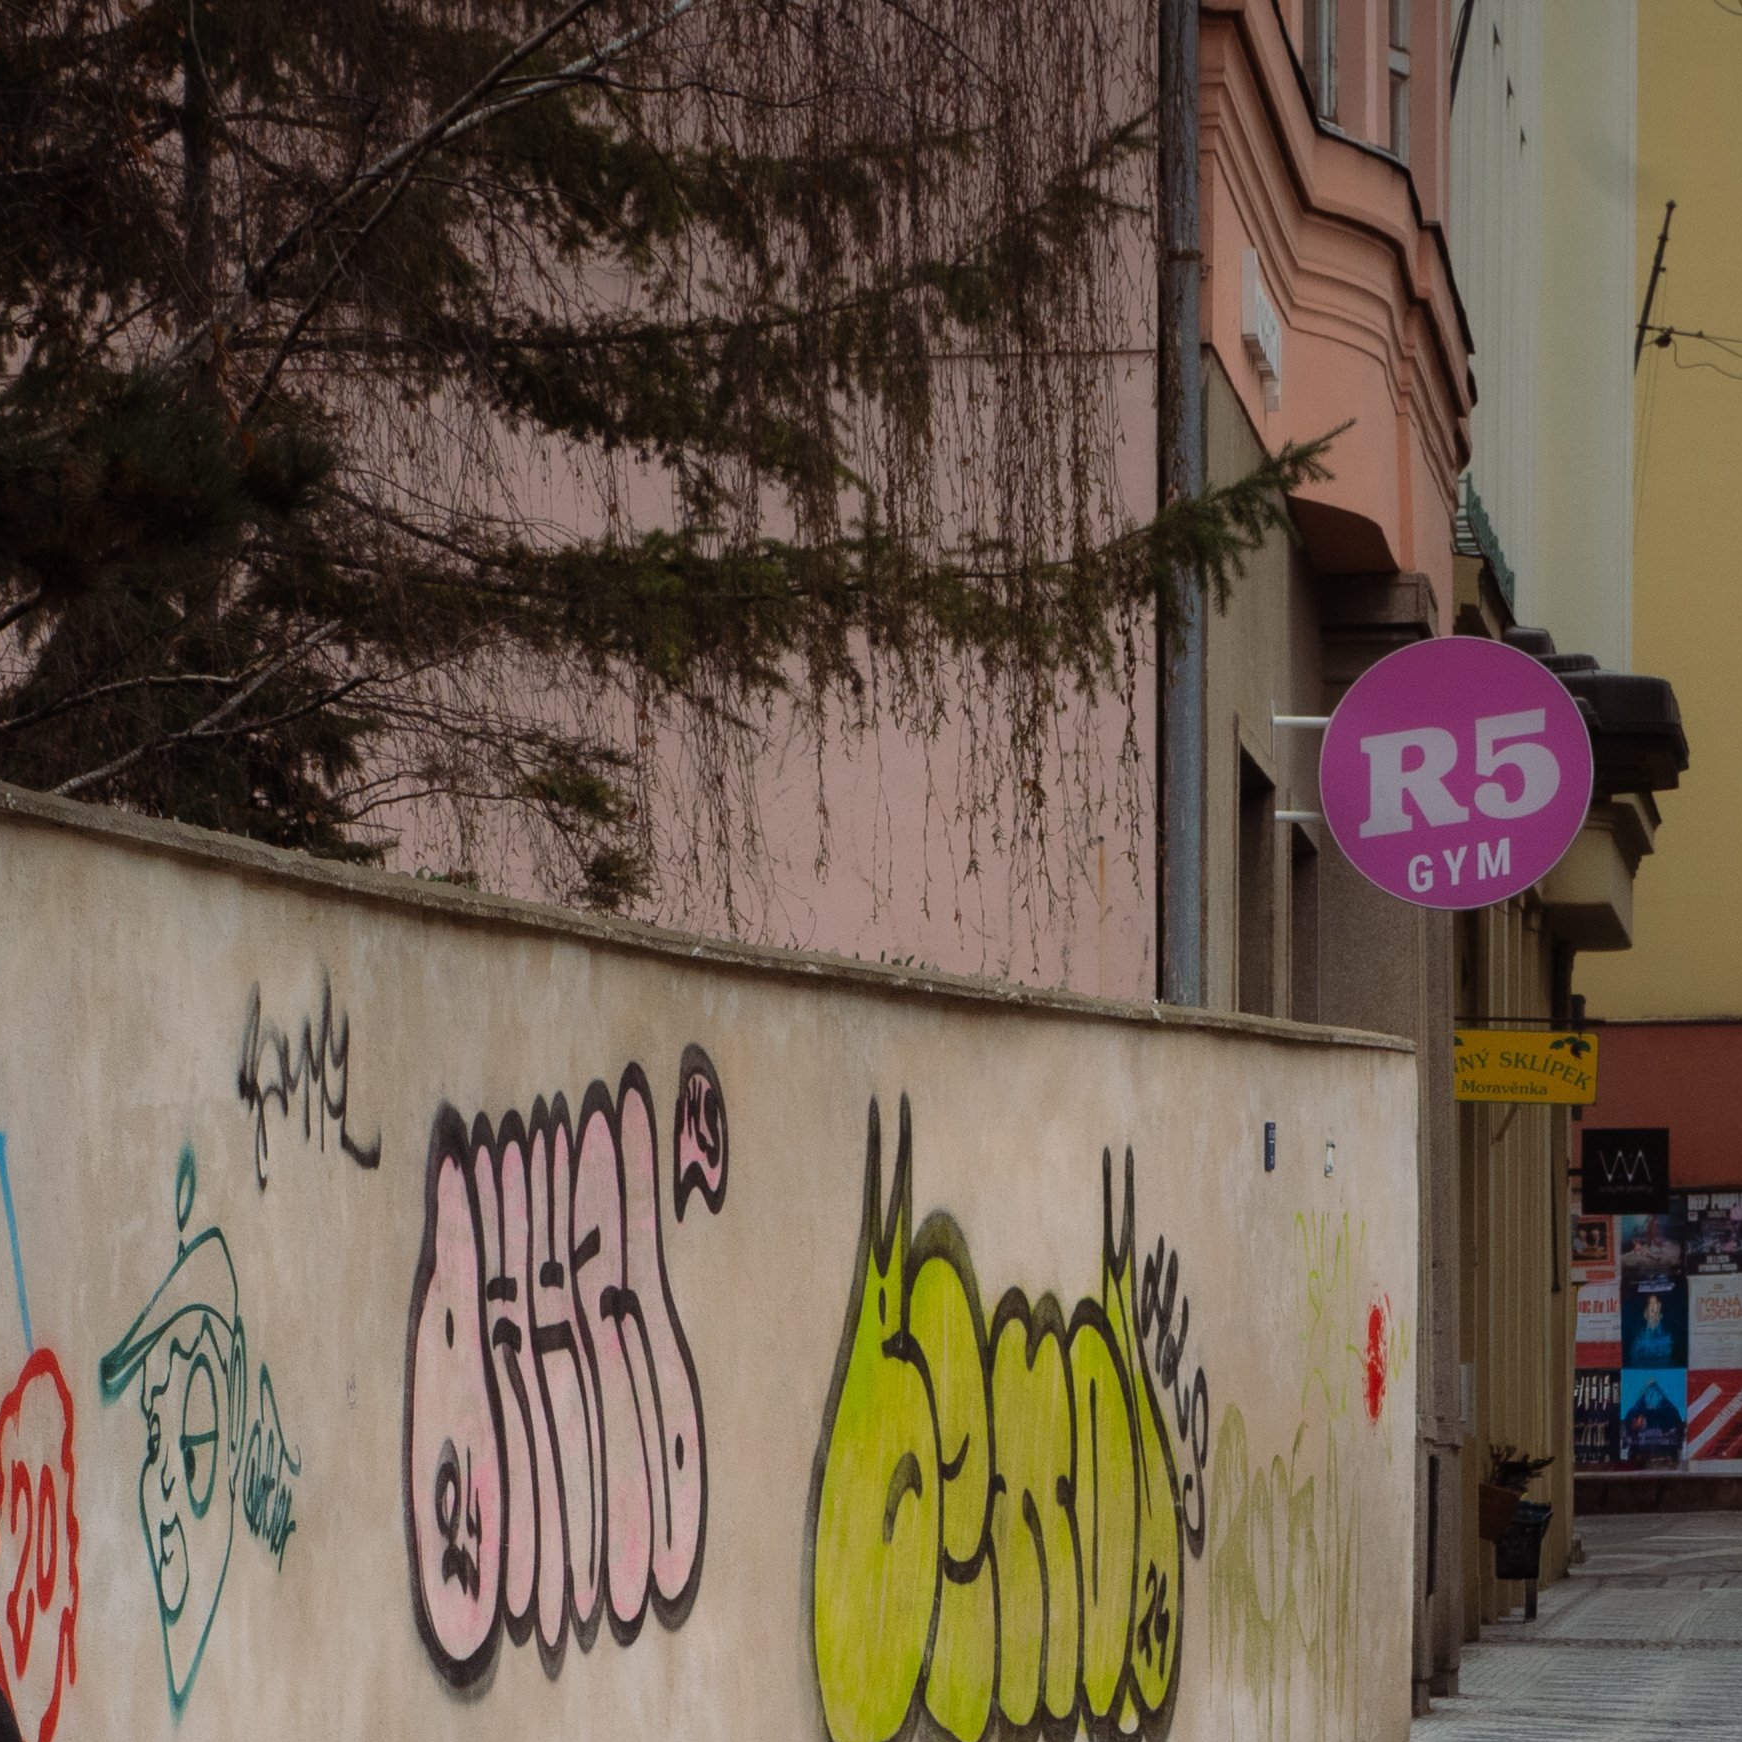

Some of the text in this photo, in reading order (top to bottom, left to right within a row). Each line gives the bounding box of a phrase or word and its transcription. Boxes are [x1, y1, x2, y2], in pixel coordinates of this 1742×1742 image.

[1359, 708, 1562, 839] R5
[1407, 837, 1512, 894] GYM
[1461, 1079, 1548, 1096] Moravěnka
[1499, 1051, 1592, 1091] SKLÍPEK
[6, 1459, 59, 1680] 20
